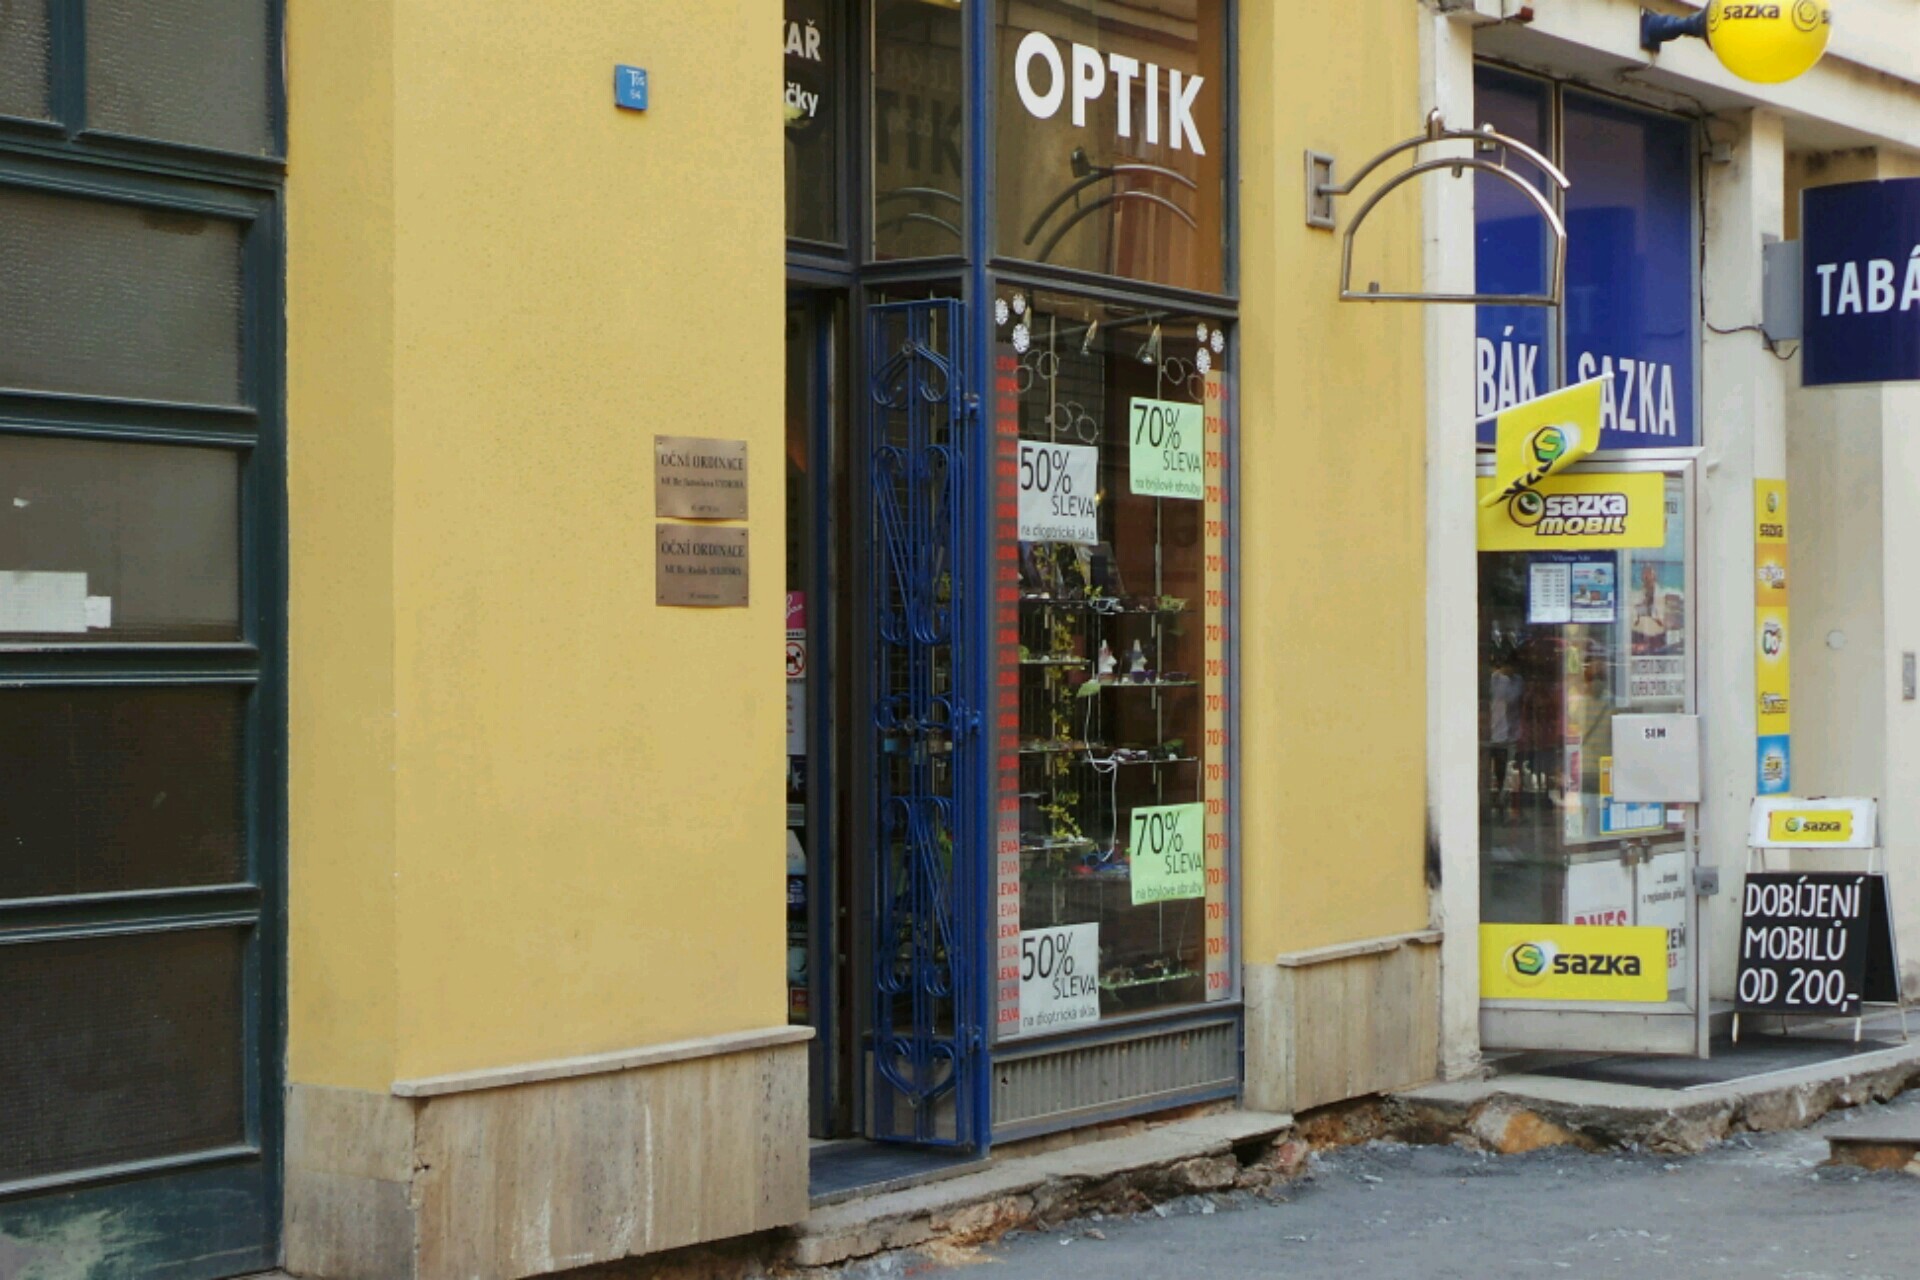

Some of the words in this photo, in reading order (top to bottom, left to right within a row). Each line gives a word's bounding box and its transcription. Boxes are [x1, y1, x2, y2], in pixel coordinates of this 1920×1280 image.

[1723, 4, 1780, 20] sazka
[784, 19, 821, 62] AŘ
[783, 81, 818, 117] čky
[1015, 31, 1206, 156] OPTIK
[1133, 404, 1182, 450] 70%
[693, 455, 744, 471] ORDINACE
[1021, 446, 1072, 494] 50%
[1163, 450, 1202, 473] SLEVA
[1052, 495, 1095, 518] SLEVA
[1545, 495, 1626, 515] sazka
[661, 539, 690, 556] OČNÍ
[693, 543, 745, 558] ORDINACE
[1134, 811, 1183, 856] 70%
[1802, 820, 1841, 832] sazka
[1165, 853, 1202, 875] SLEVA
[1744, 875, 1864, 918] DOBÍJENÍ
[1744, 919, 1847, 960] MOBILŮ
[1022, 931, 1074, 982] 50%
[1553, 952, 1641, 976] sazka
[1052, 974, 1097, 1000] SLEVA
[1739, 968, 1778, 1005] OD
[1785, 968, 1859, 1013] 200,-
[1023, 1016, 1034, 1028] na
